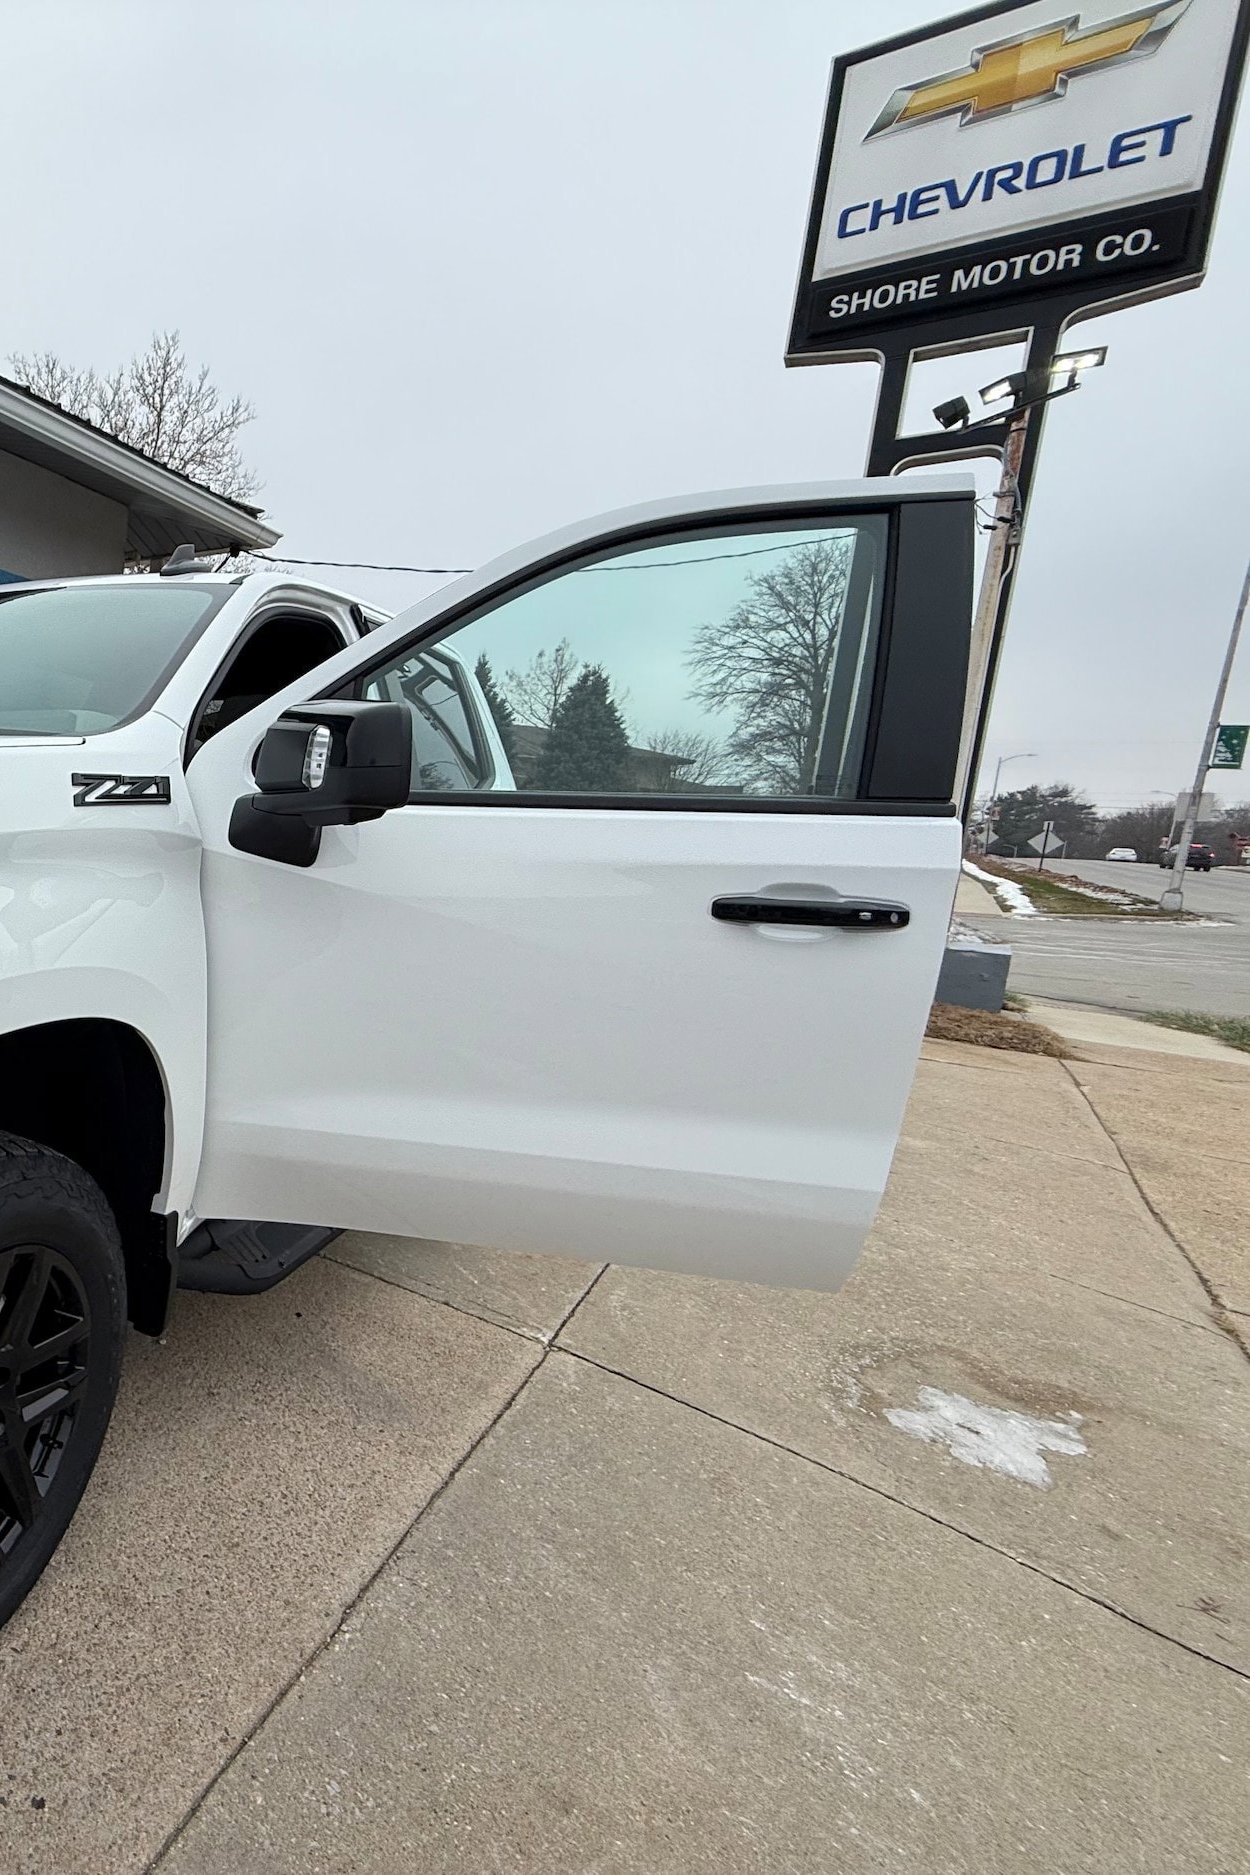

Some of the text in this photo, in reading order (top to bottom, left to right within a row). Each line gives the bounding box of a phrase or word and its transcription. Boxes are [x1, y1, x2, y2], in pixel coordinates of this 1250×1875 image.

[837, 114, 1192, 239] CHEVROLET
[829, 228, 1161, 319] SHORE MOTOR CO.
[71, 773, 171, 807] Z71
